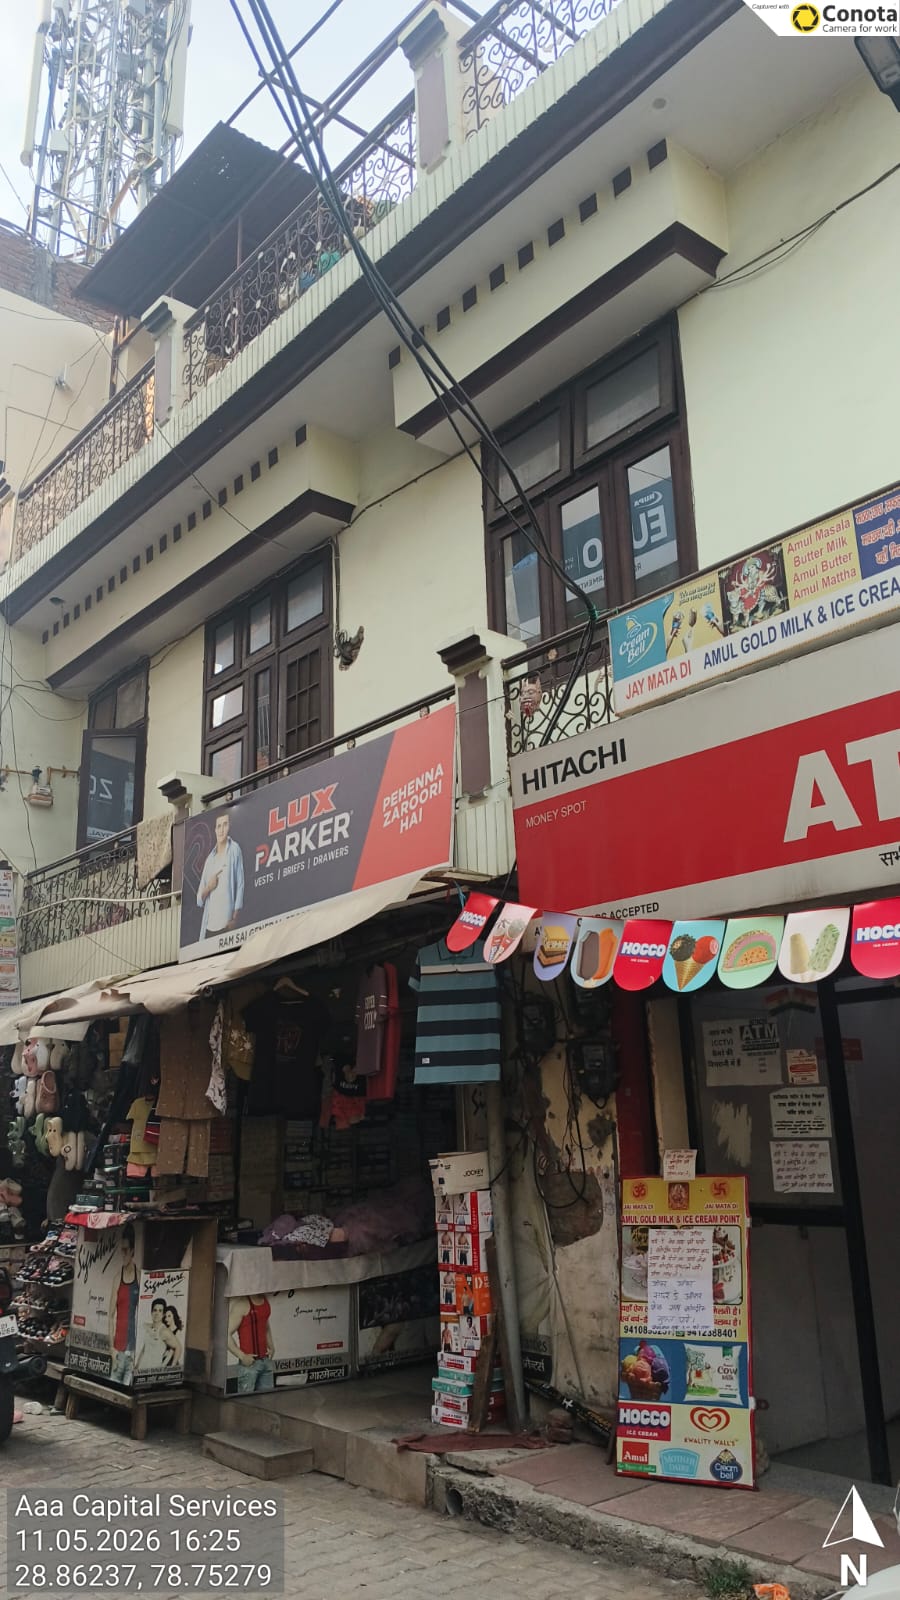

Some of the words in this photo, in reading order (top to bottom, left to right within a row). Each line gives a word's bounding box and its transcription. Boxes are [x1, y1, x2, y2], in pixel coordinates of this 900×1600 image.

[786, 537, 813, 554] Amul
[815, 519, 851, 541] Masala
[794, 548, 824, 568] Butter
[826, 536, 848, 553] Milk
[792, 568, 819, 585] Amul
[822, 552, 853, 572] Butter
[793, 584, 820, 600] Amul
[822, 566, 856, 588] Mattha
[619, 627, 650, 656] Cream
[626, 678, 644, 700] JAY
[648, 666, 677, 692] MATA
[680, 660, 691, 677] DI
[704, 645, 738, 670] AMUL
[741, 625, 776, 654] GOLD
[780, 610, 814, 638] MILK
[818, 606, 828, 624] &
[830, 594, 855, 618] ICE
[628, 642, 646, 665] Bell
[522, 738, 627, 795] HITACHI
[383, 763, 444, 812] PEHENNA
[268, 782, 339, 836] LUX
[383, 781, 442, 828] ZAROORI
[526, 808, 558, 829] MONEY
[560, 800, 587, 818] SPOT
[400, 808, 423, 834] HAI
[254, 812, 351, 872] PARKER
[254, 872, 274, 888] VESTS
[283, 860, 305, 878] BRIEFS
[313, 845, 350, 868] DRAWERS
[460, 911, 486, 926] HOCCO
[610, 902, 660, 920] ACCEPTED
[218, 934, 234, 949] RAM
[620, 942, 666, 958] HOCCO
[742, 1023, 778, 1040] ATM
[712, 1039, 734, 1047] (CCTV)
[463, 1168, 484, 1177] JOCKEY
[621, 1216, 638, 1224] AMUL
[695, 1215, 718, 1223] CREAM
[720, 1215, 740, 1223] POINT
[144, 1272, 184, 1294] Signature
[274, 1360, 291, 1370] Vest
[295, 1357, 312, 1367] Brief
[317, 1354, 342, 1366] Panties
[717, 1366, 737, 1375] Cow
[619, 1408, 670, 1426] HOCCO
[684, 1437, 711, 1445] KWALITY
[623, 1451, 648, 1462] Amul
[664, 1455, 695, 1465] MOTHER
[715, 1463, 738, 1472] Cream
[720, 1471, 734, 1480] bell
